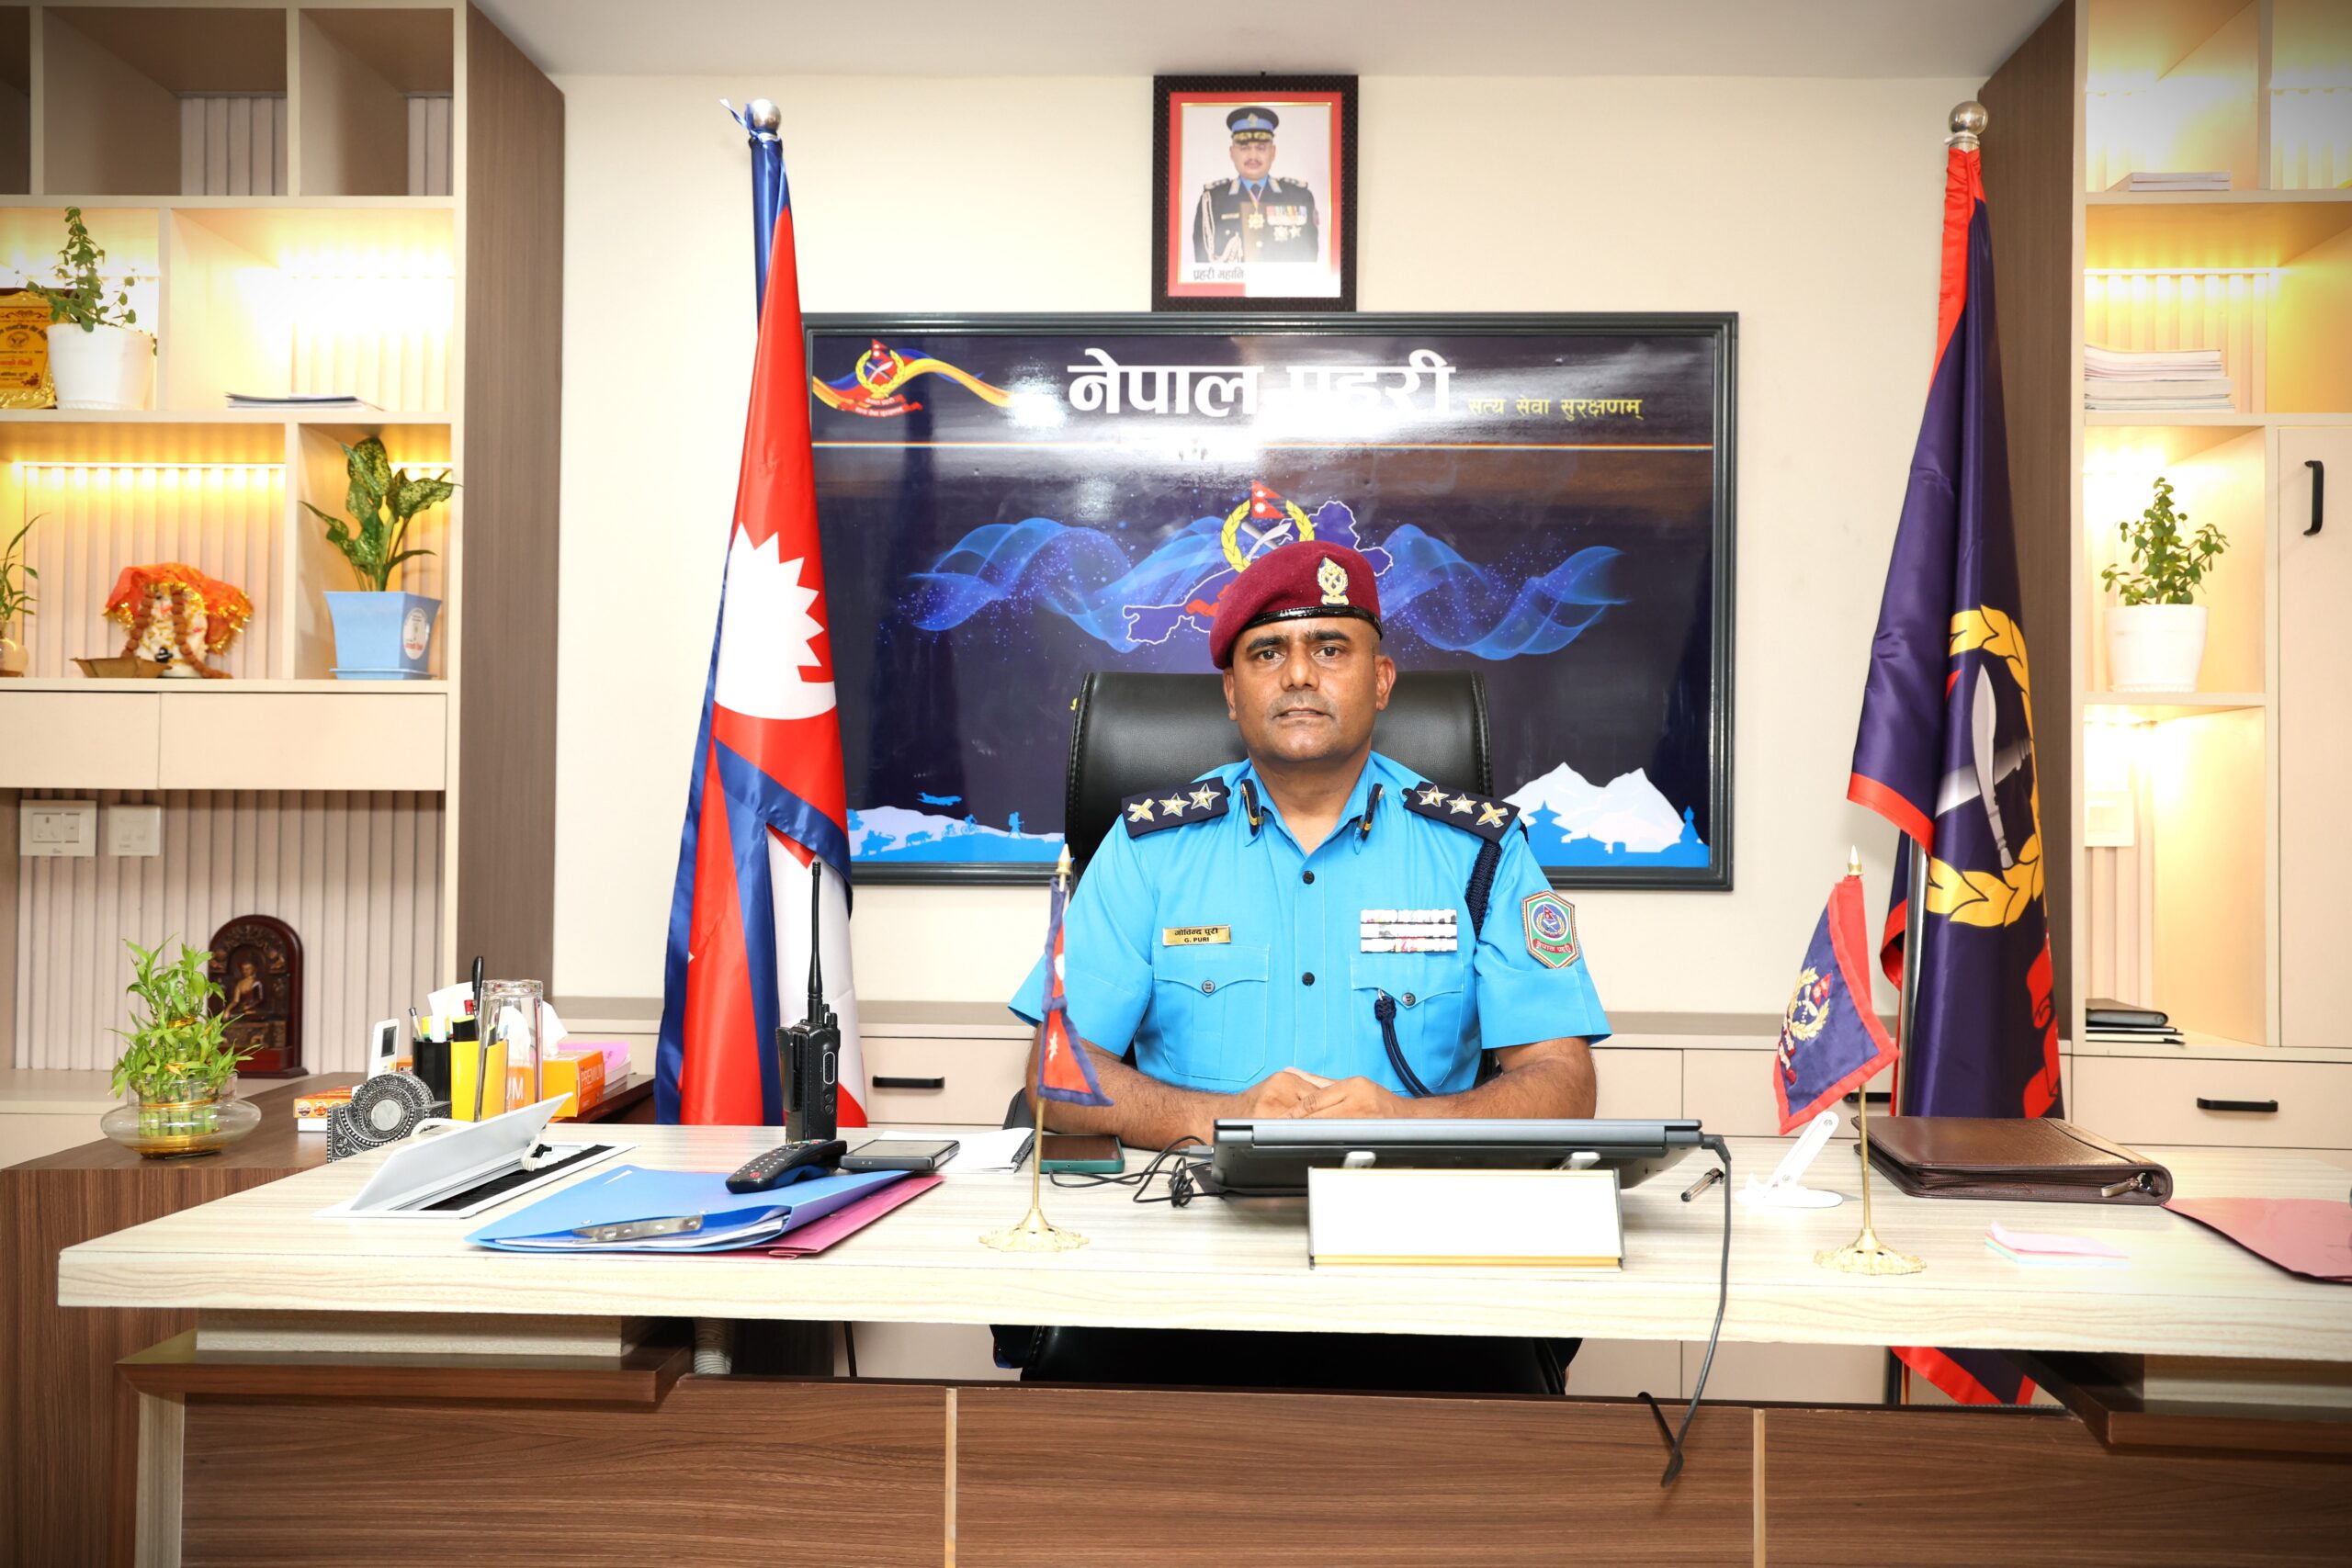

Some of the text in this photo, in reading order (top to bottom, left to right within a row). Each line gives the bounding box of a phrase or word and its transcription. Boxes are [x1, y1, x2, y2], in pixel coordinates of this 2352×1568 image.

[1217, 266, 1245, 280] महानि
[1067, 347, 1264, 417] नेपाल
[1468, 394, 1645, 422] सत्य सेवा सुरक्षणम्
